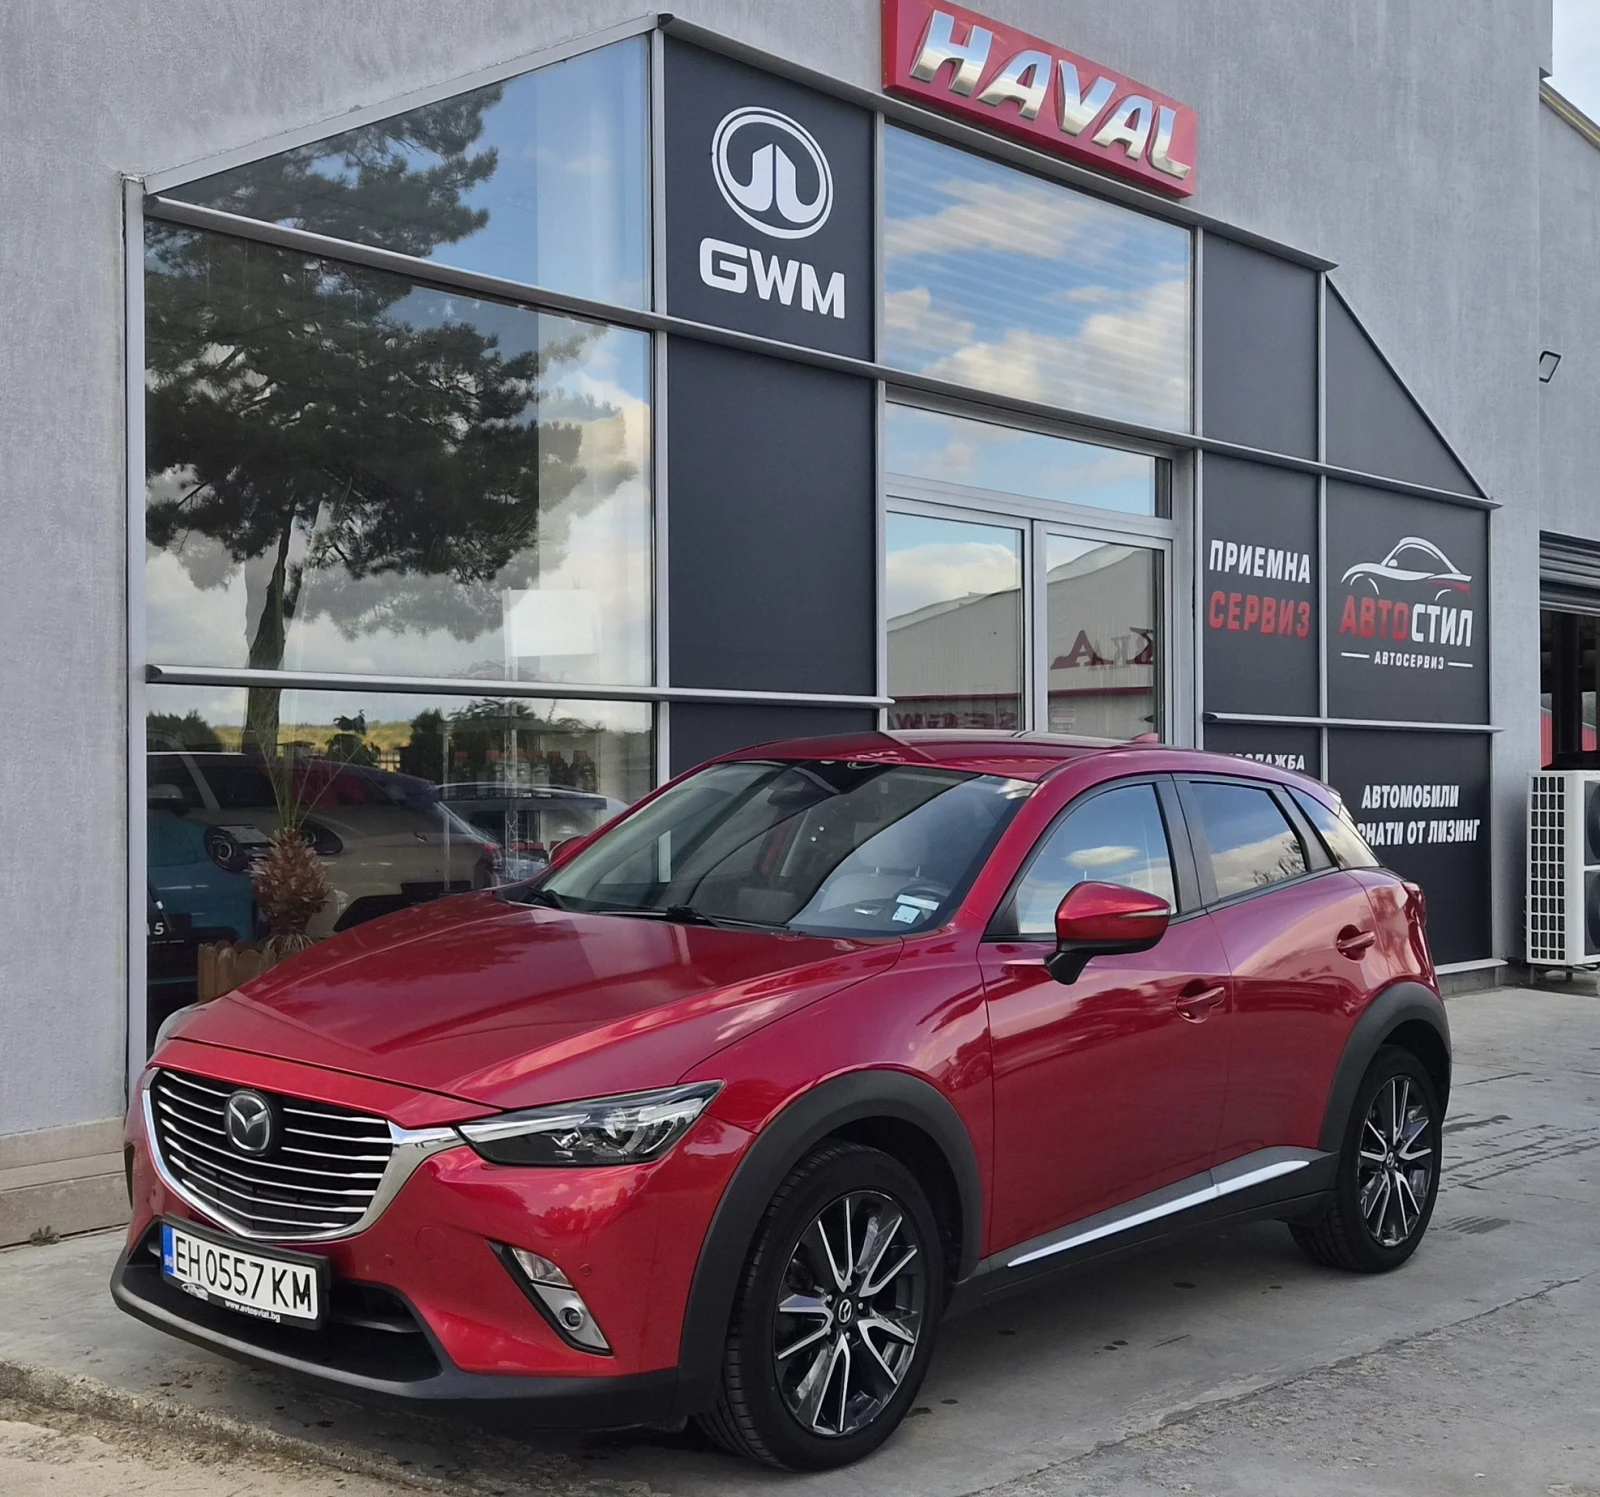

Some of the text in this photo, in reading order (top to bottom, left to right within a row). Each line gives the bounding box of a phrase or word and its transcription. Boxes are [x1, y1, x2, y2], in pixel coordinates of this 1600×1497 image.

[909, 9, 1192, 179] HAVAL
[699, 237, 845, 319] GWM
[1209, 539, 1311, 584] ПРИЕМНА
[1209, 591, 1311, 638] СЕРВИЗ
[1339, 595, 1474, 647] АВТОСТИЛ
[1374, 651, 1445, 670] АВТОСЕРВИЗ
[1361, 784, 1460, 809] АВТОМОБИЛИ
[1407, 820, 1426, 845] ОТ
[1428, 819, 1481, 844] ЛИЗИНГ
[175, 1236, 201, 1281] EH
[205, 1249, 265, 1300] 0557
[271, 1267, 313, 1313] KM
